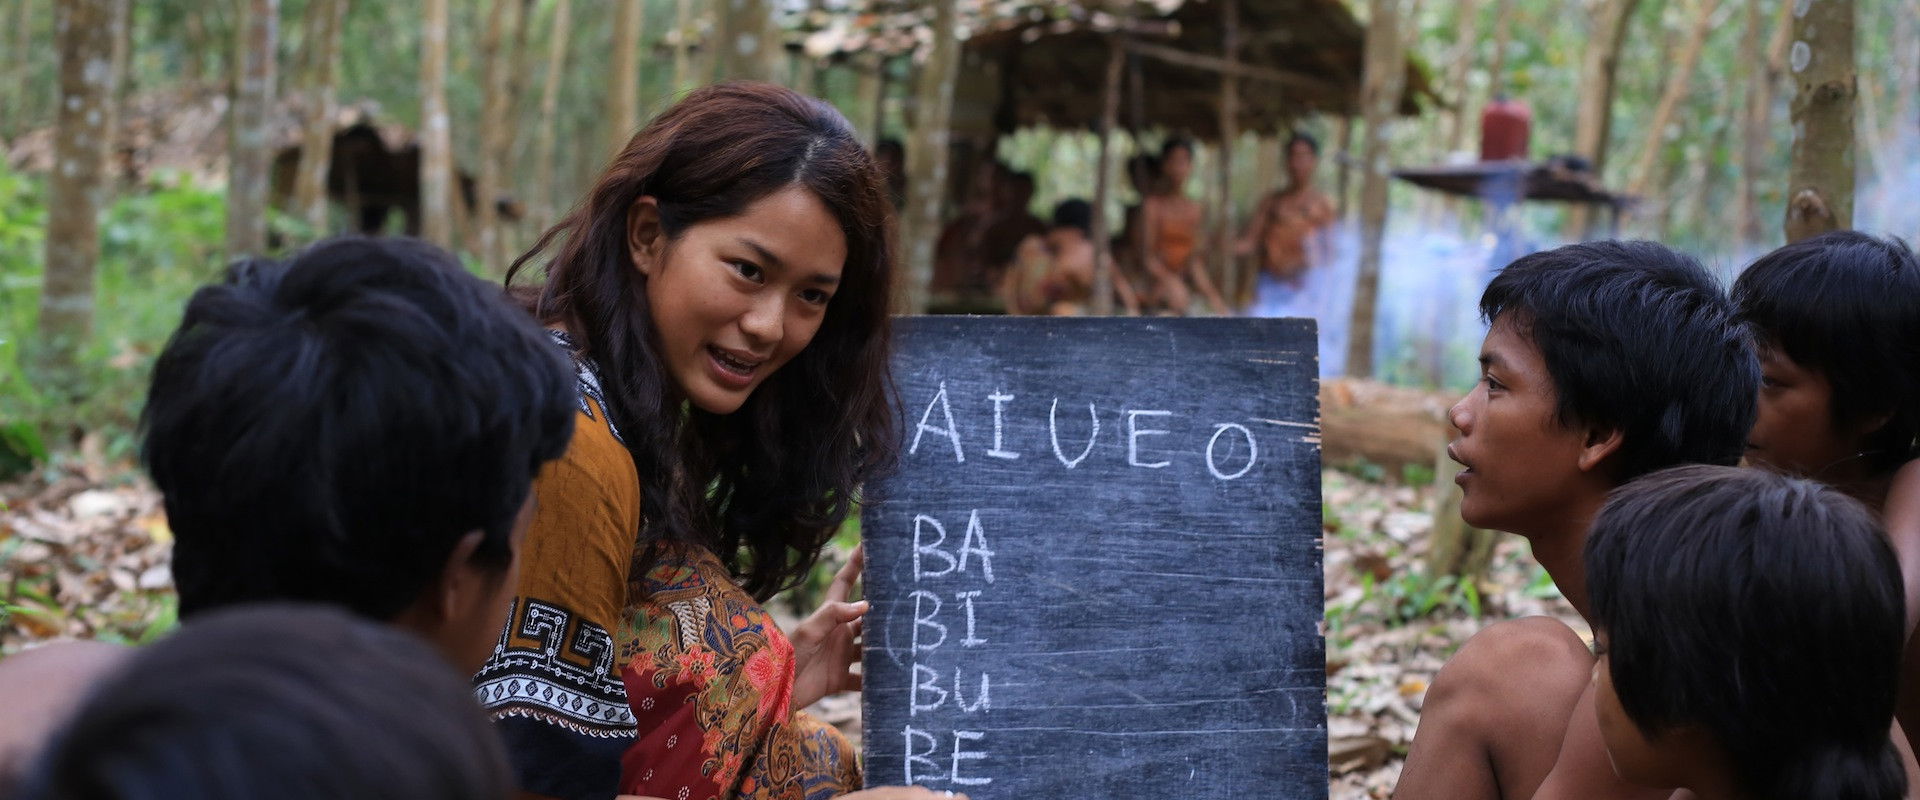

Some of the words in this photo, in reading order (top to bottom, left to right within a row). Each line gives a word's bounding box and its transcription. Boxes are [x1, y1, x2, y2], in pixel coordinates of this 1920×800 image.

[912, 508, 996, 584] BA
[908, 590, 988, 658] BI
[900, 724, 993, 786] BE
